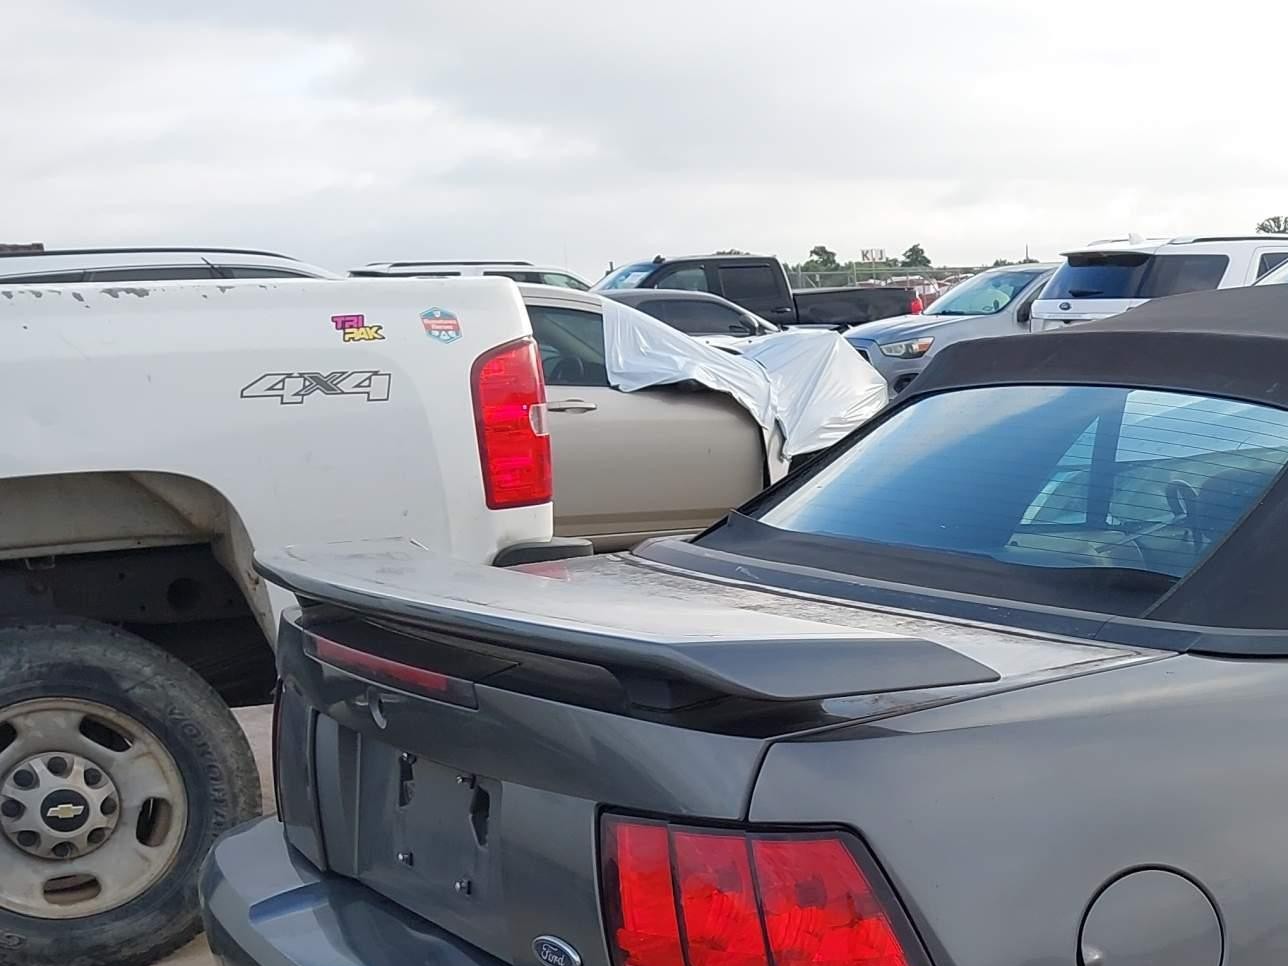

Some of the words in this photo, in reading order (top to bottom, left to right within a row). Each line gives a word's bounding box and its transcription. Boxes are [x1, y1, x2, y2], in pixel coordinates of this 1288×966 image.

[331, 314, 365, 330] TRI
[343, 325, 386, 342] PAK
[540, 943, 566, 966] Ford
